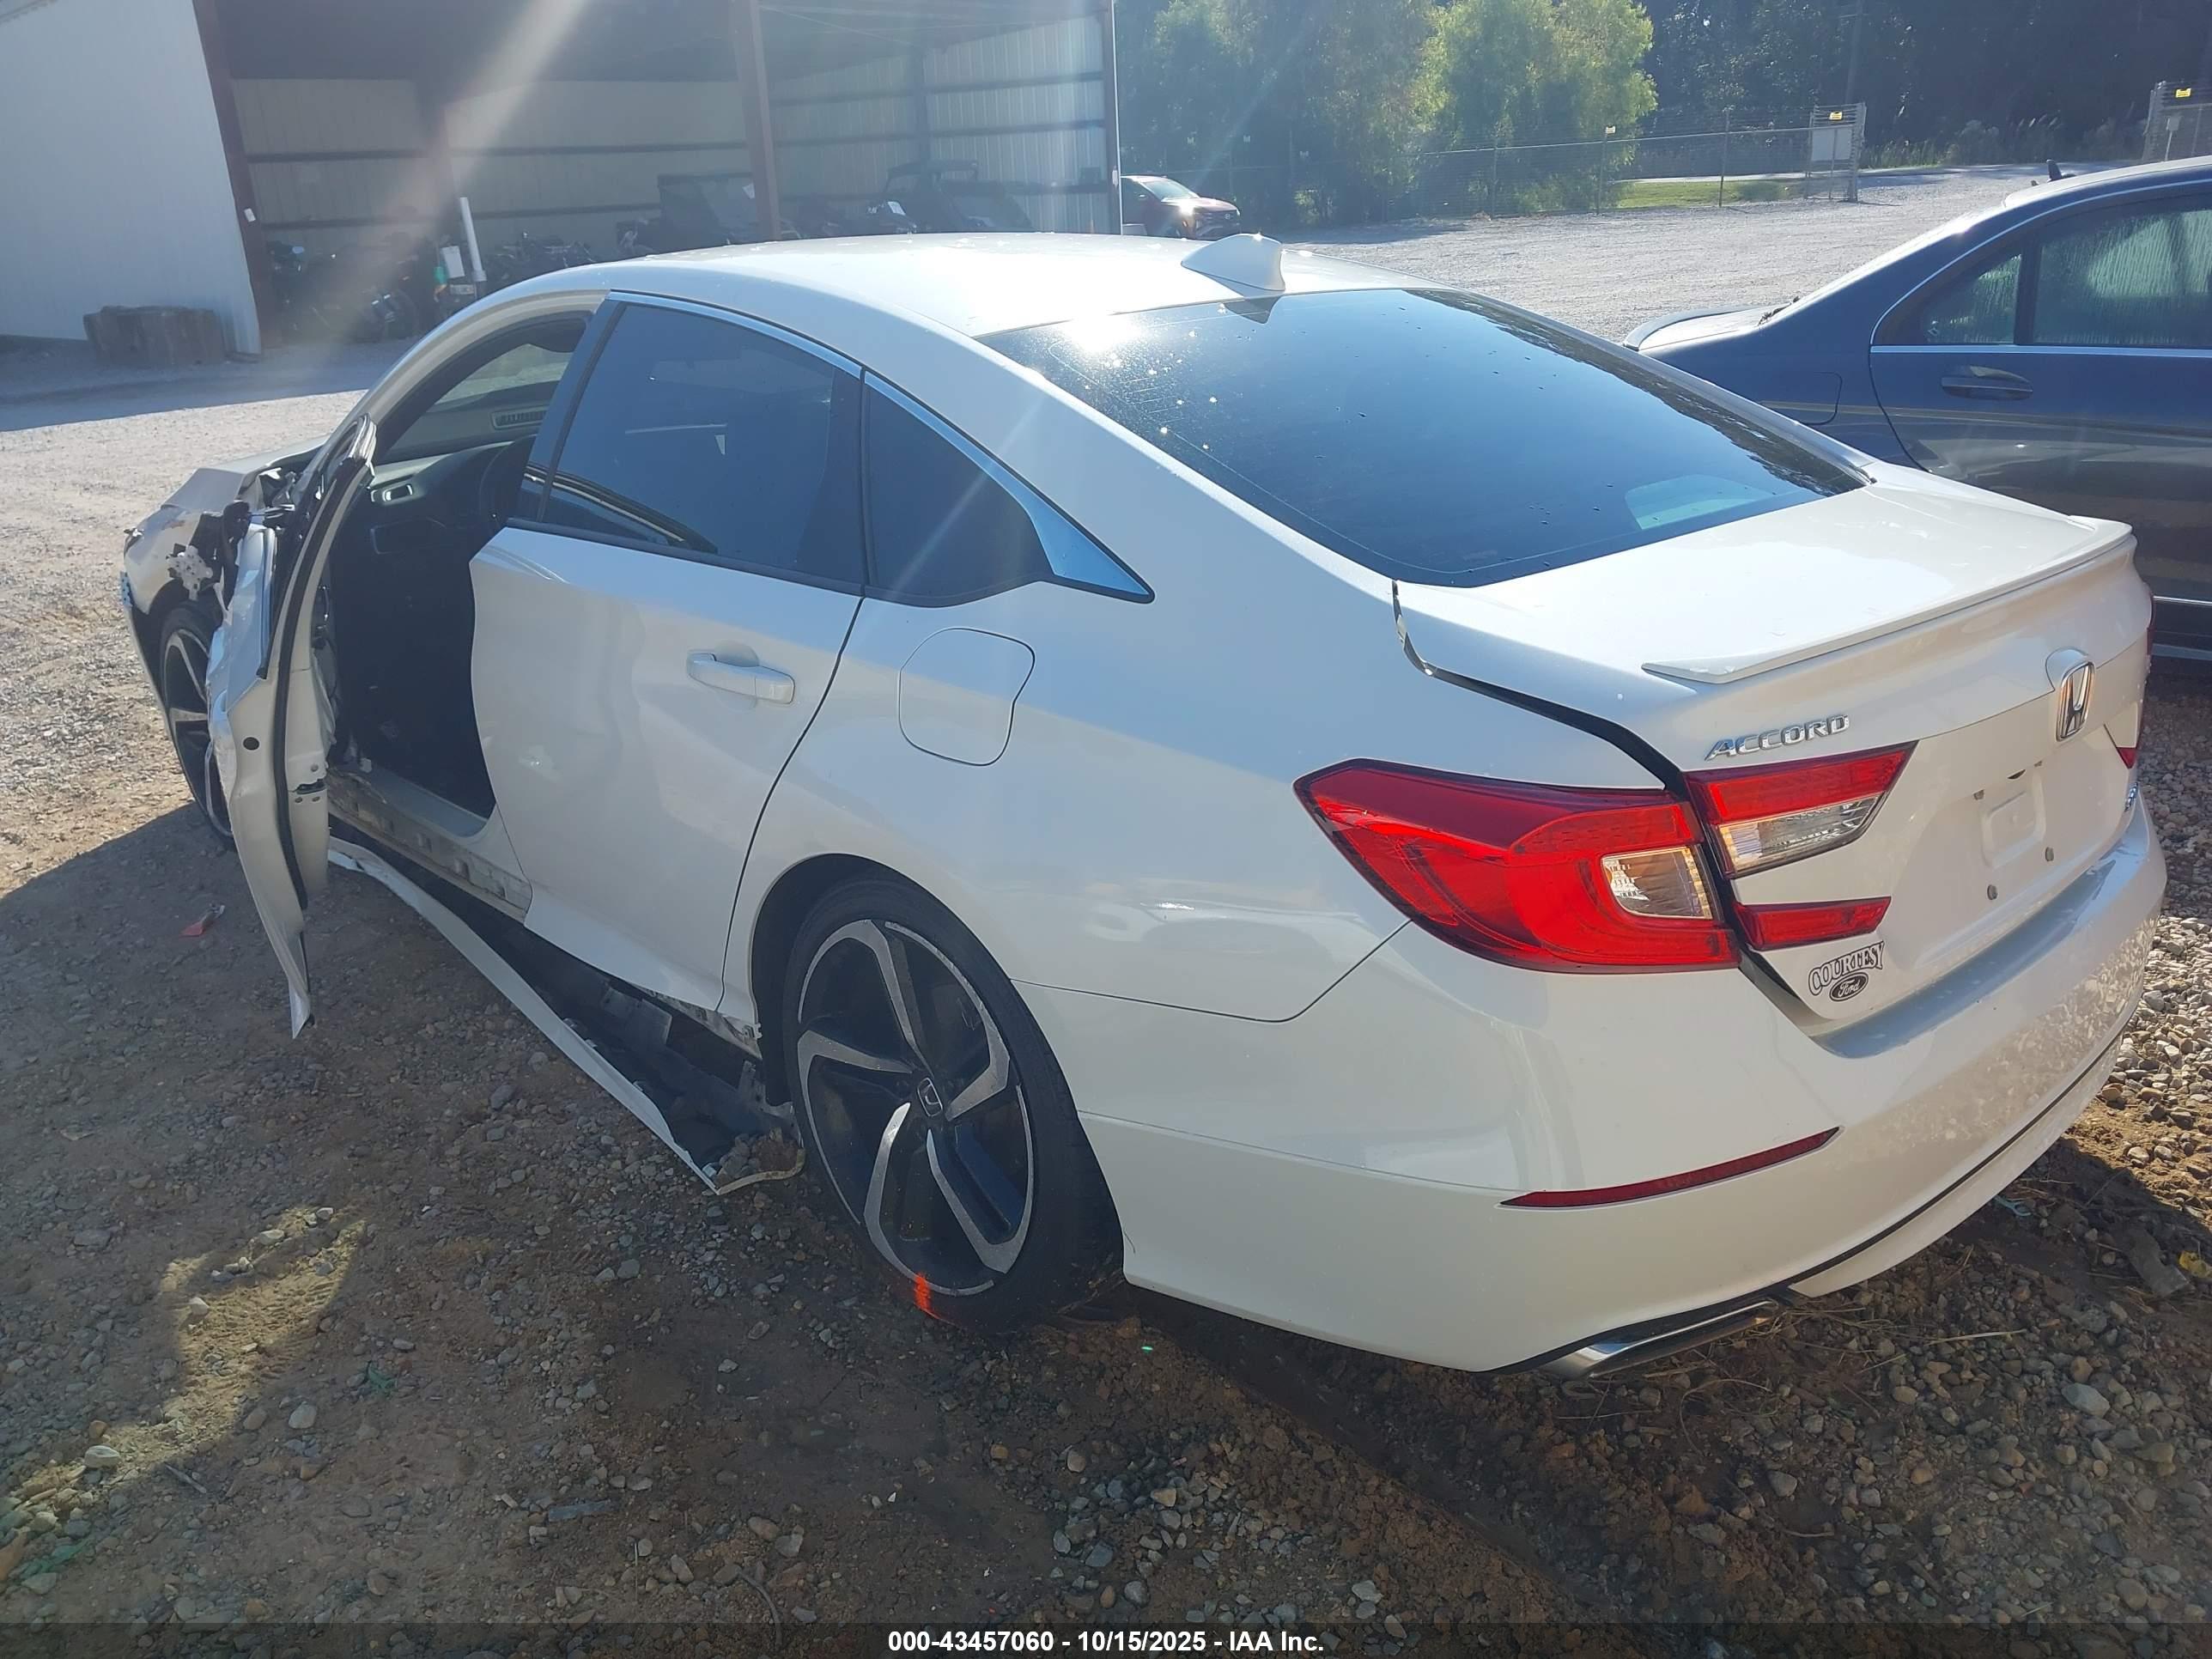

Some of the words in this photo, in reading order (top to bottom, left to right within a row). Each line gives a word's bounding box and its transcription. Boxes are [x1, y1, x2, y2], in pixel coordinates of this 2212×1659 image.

[1705, 714, 1850, 762] ACCORD
[1808, 939, 1885, 996] COURTESY
[1838, 979, 1862, 998] Ford
